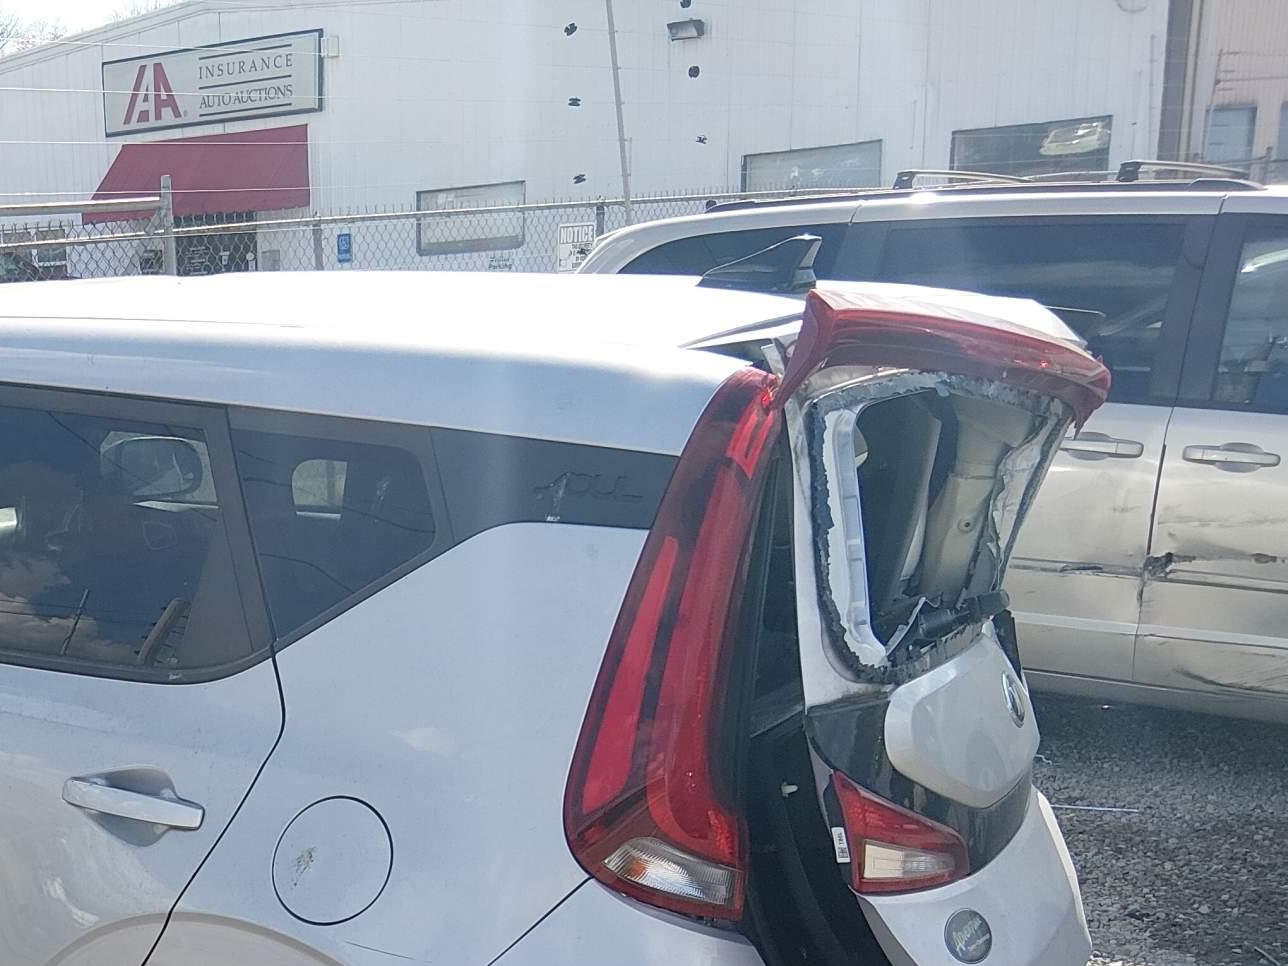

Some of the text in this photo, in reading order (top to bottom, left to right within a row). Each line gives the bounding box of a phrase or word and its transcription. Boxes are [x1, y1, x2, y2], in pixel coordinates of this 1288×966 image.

[198, 54, 293, 80] INSURANCE
[200, 84, 293, 109] AUTO AUCTIONS
[560, 226, 593, 243] NOTICE
